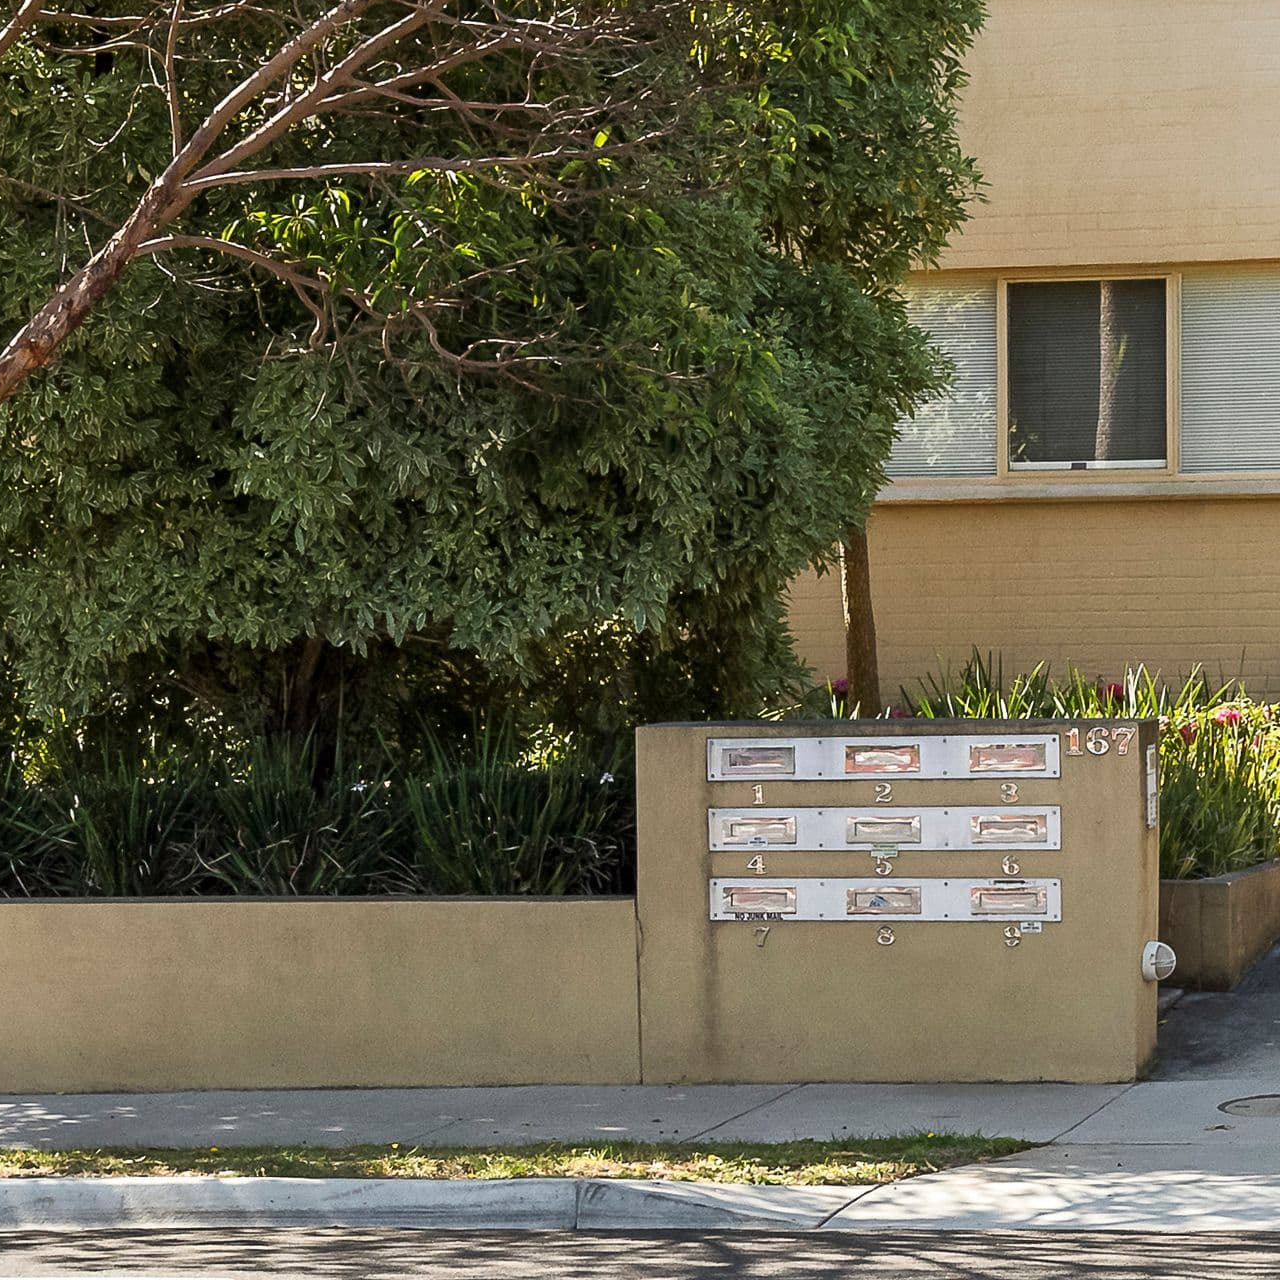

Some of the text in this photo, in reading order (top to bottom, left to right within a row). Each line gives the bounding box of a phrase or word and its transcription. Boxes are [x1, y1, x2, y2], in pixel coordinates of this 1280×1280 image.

[1065, 727, 1136, 755] 167
[752, 784, 767, 805] 1
[875, 782, 893, 803] 2
[1000, 783, 1019, 803] 3
[747, 854, 767, 875] 4
[874, 855, 893, 876] 5
[1001, 855, 1020, 876] 6
[735, 912, 784, 921] NO JUNK MAIL
[753, 926, 770, 948] 7
[876, 926, 896, 946] 8
[1004, 926, 1021, 947] 9
